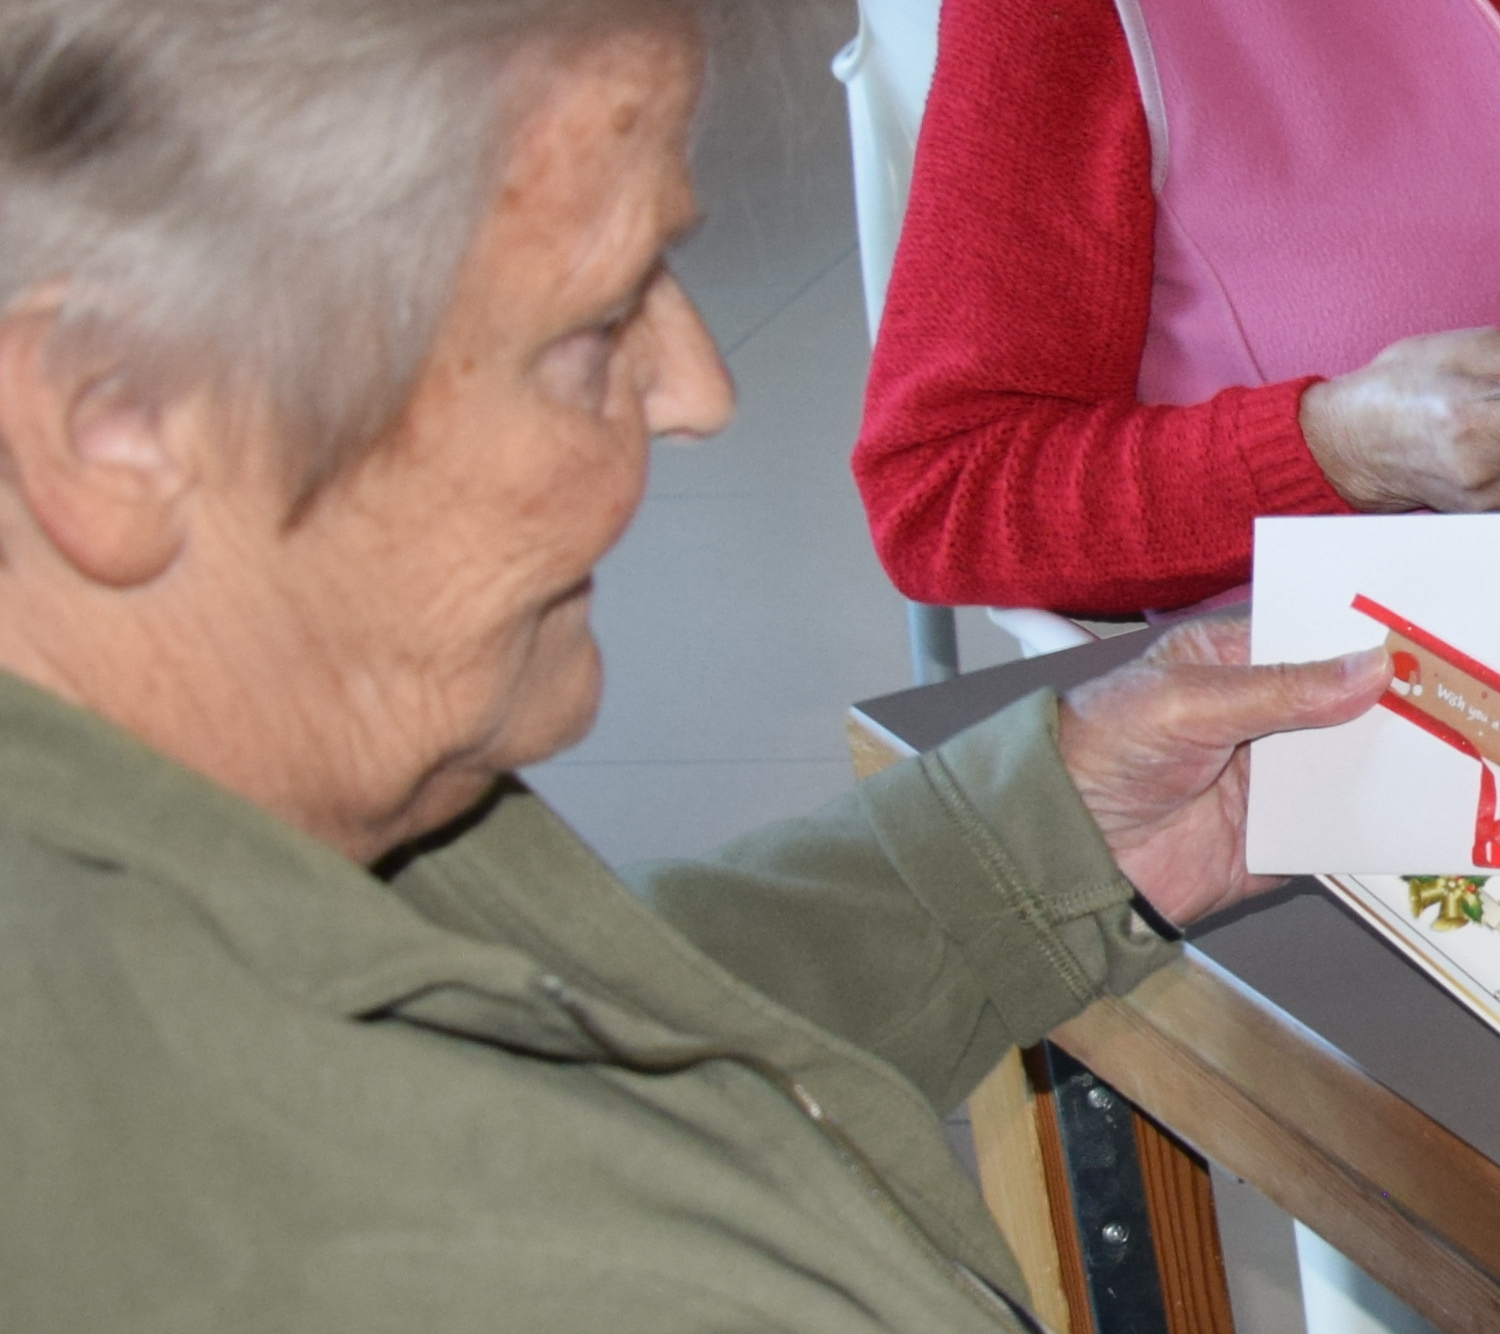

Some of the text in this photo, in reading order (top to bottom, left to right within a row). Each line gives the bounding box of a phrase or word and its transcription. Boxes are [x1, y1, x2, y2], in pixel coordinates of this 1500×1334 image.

[1437, 683, 1465, 711] Wish
[1467, 706, 1489, 723] you
[1491, 720, 1500, 731] a
